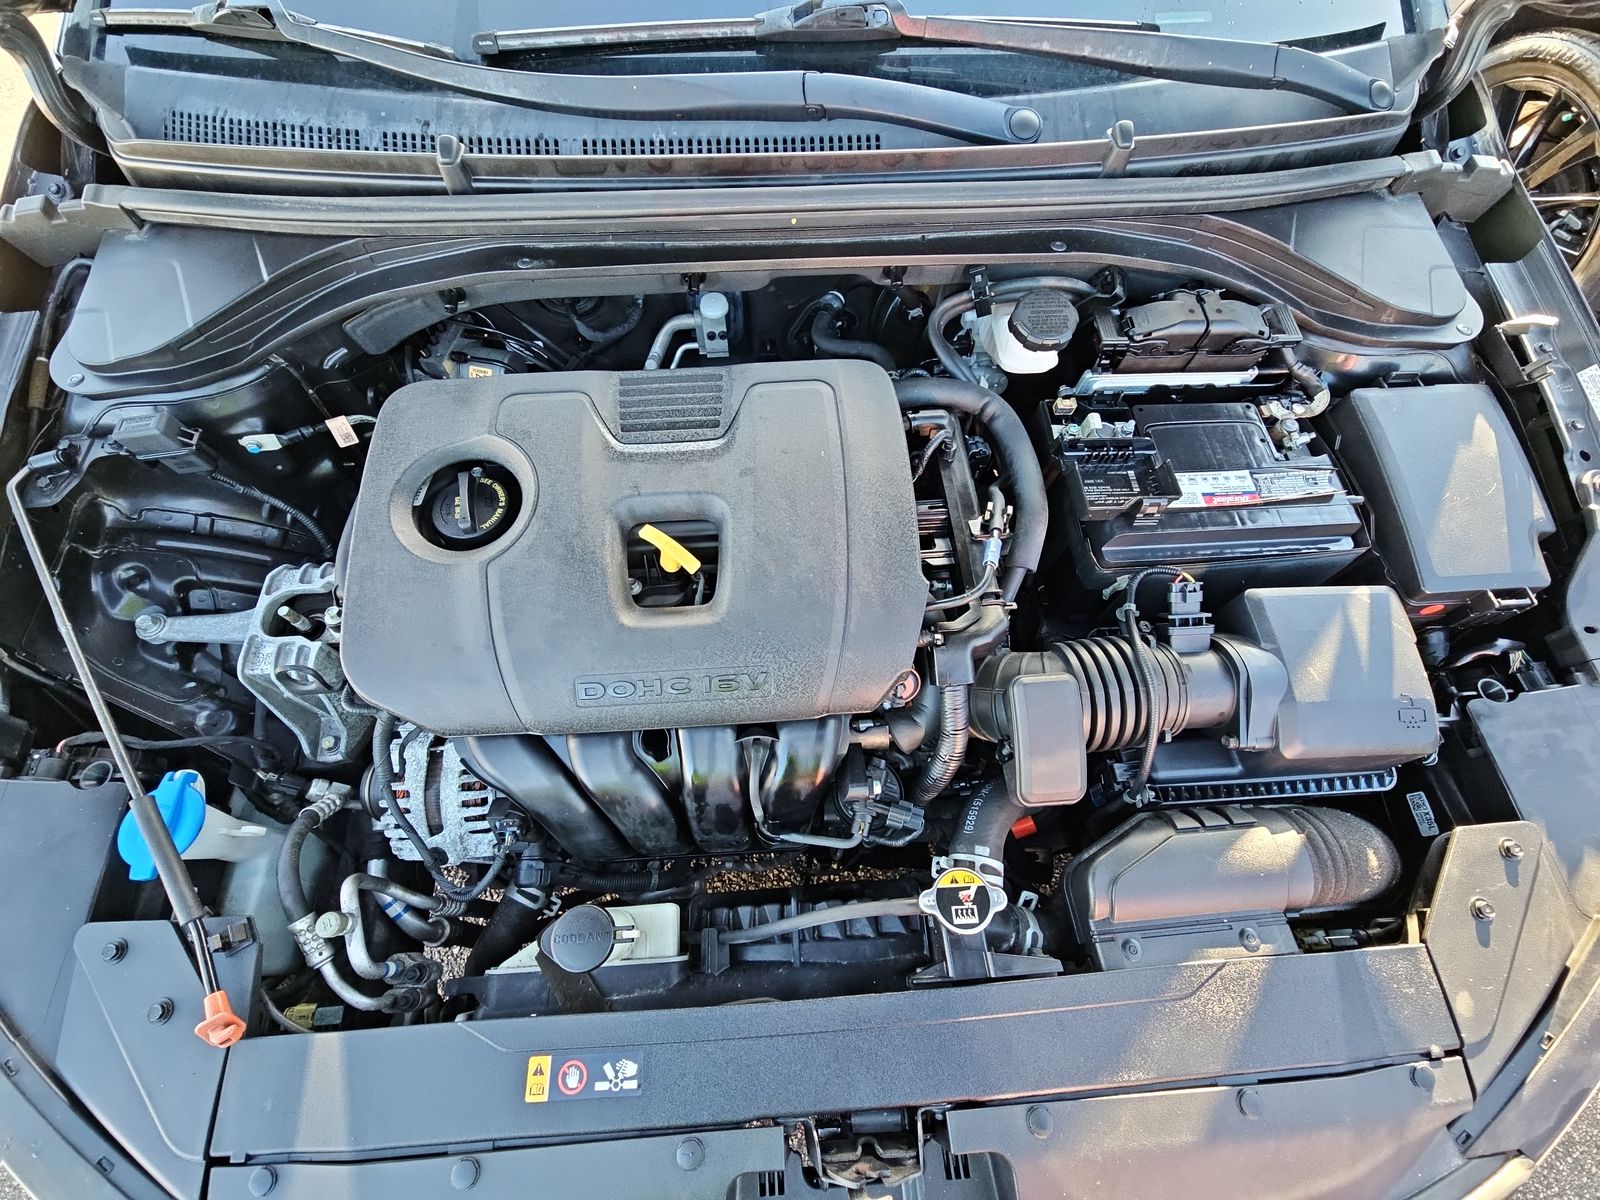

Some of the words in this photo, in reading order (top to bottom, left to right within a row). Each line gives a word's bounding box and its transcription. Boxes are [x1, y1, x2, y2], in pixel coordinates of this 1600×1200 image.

[480, 477, 493, 486] SEE
[480, 508, 504, 529] MANUAL
[577, 676, 691, 701] DOHC
[702, 671, 768, 694] 16V
[963, 798, 984, 834] (515929)
[553, 930, 612, 945] COOLANT
